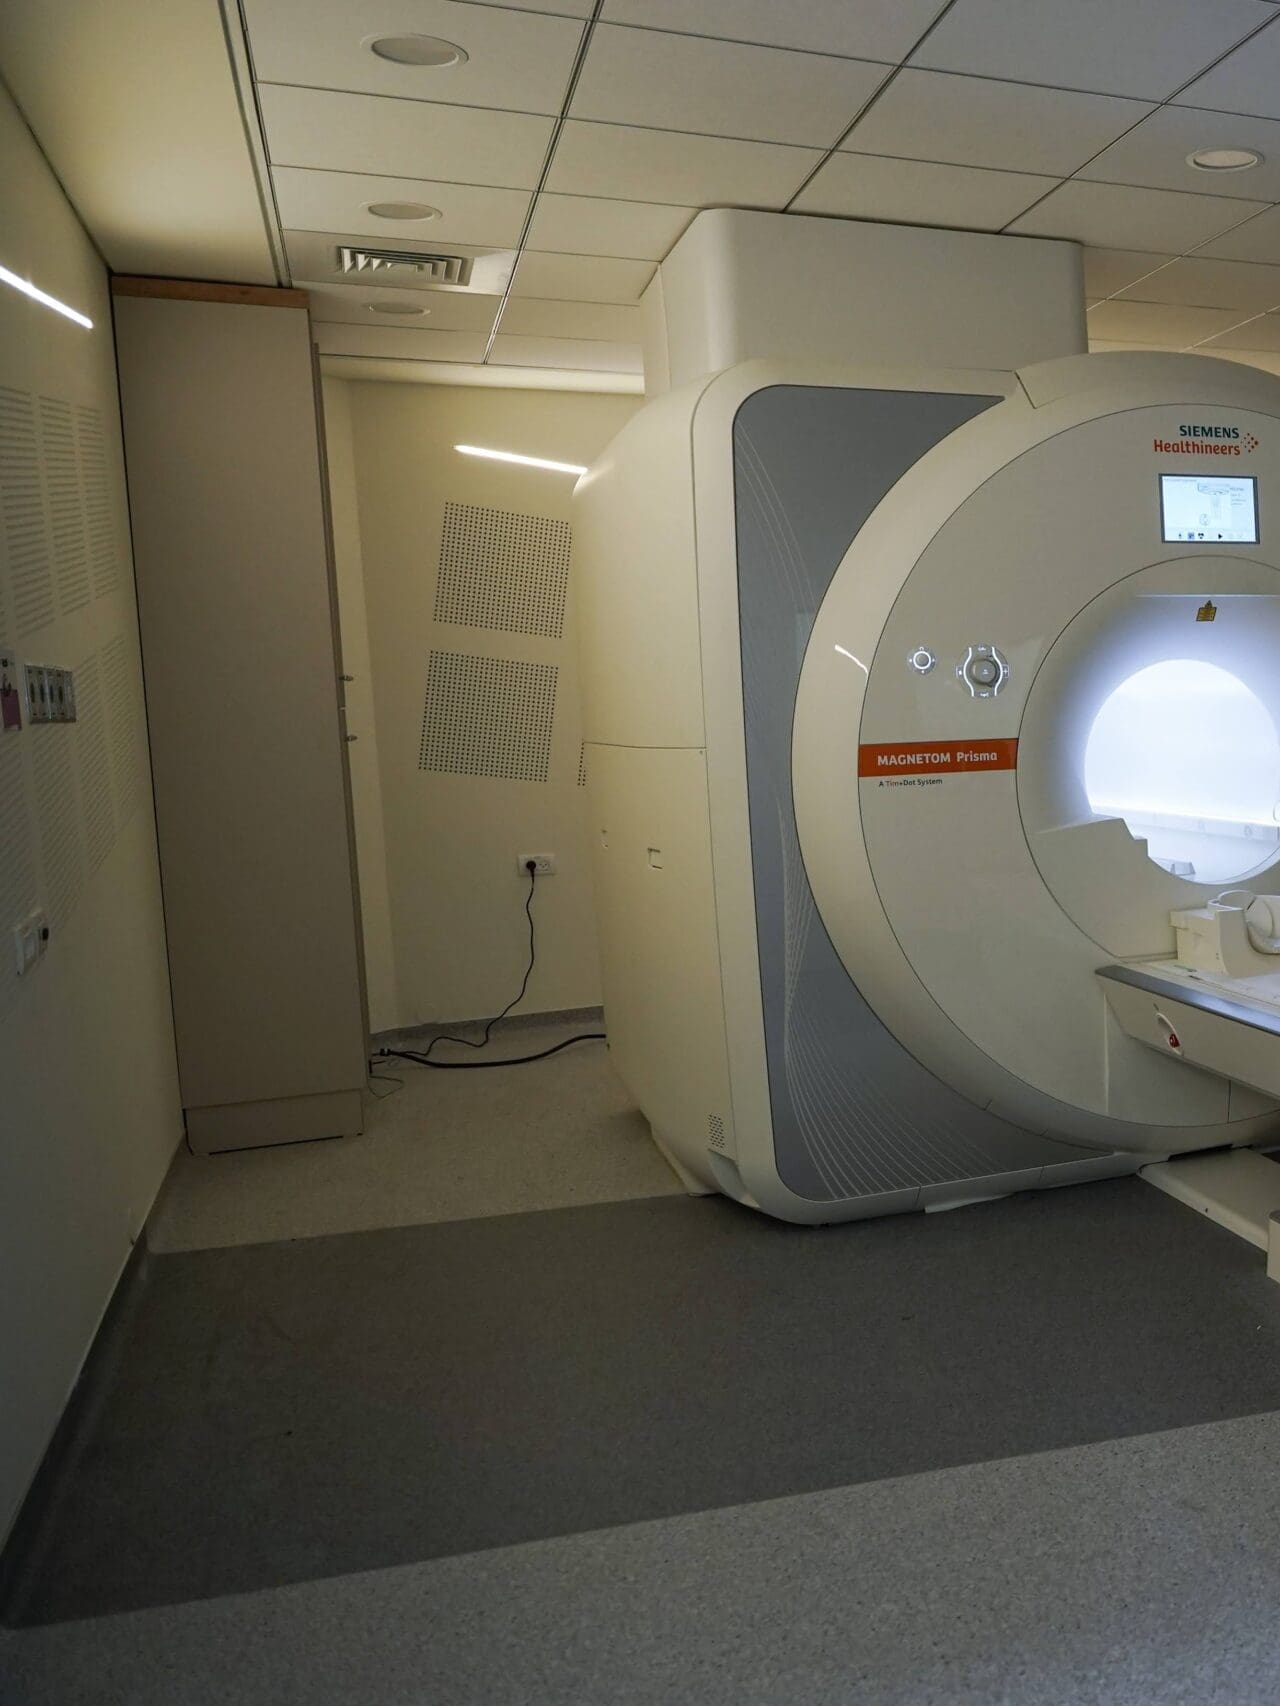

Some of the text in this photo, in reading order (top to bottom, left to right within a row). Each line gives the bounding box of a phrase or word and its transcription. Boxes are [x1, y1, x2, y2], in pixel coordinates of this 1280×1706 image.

[1179, 425, 1239, 439] SIEMENS
[1154, 439, 1241, 456] Healthineers
[877, 750, 998, 766] MAGNETOM Prisma
[917, 778, 943, 787] System
